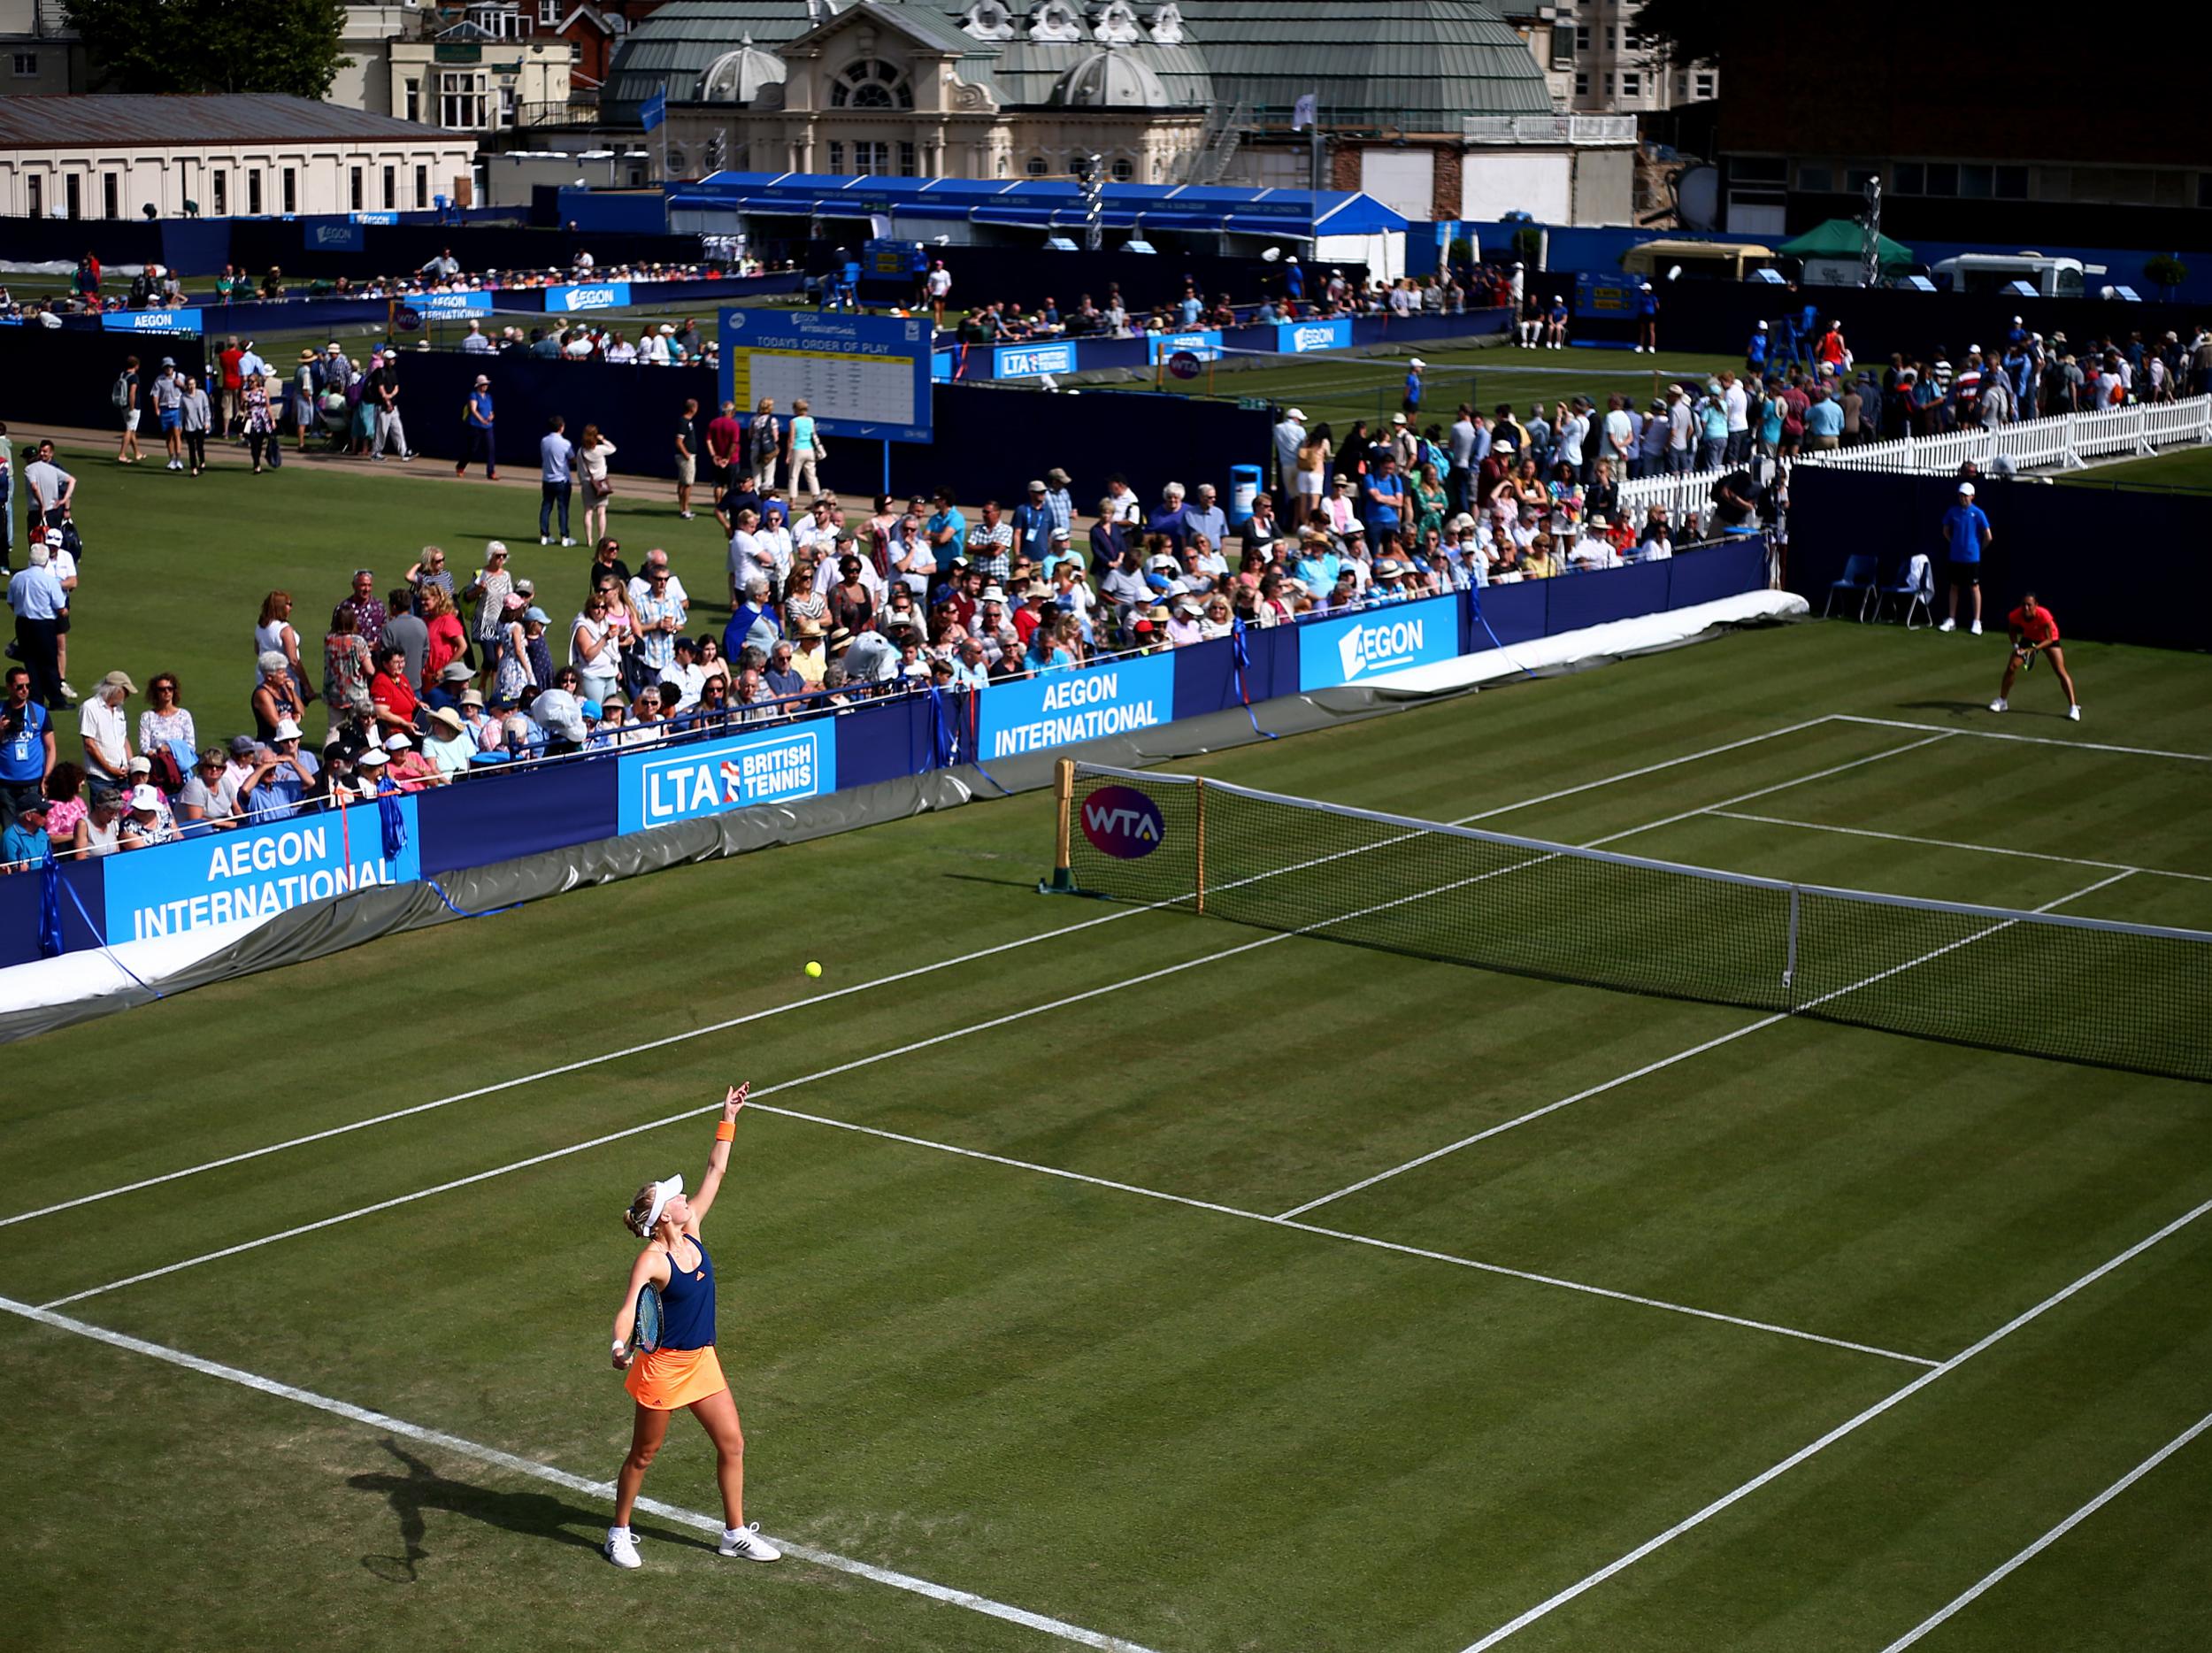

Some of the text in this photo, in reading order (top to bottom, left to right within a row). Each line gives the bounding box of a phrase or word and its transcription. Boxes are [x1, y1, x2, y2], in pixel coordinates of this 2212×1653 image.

[565, 288, 614, 311] AEGON
[134, 314, 173, 327] AEGON
[801, 339, 840, 351] ORDER
[842, 342, 859, 352] OF
[862, 343, 889, 355] PLAY
[1294, 327, 1334, 352] AEGON
[1003, 354, 1031, 374] LTA
[1339, 619, 1424, 680] AEGON
[1042, 673, 1118, 711] AEGON
[995, 701, 1158, 756] INTERNATIONAL
[742, 745, 811, 777] BRITISH
[651, 765, 720, 818] LTA
[744, 765, 812, 798] TENNIS
[1086, 803, 1159, 842] WTA
[207, 826, 326, 882] AEGON
[134, 858, 396, 941] INTERNATIONAL
